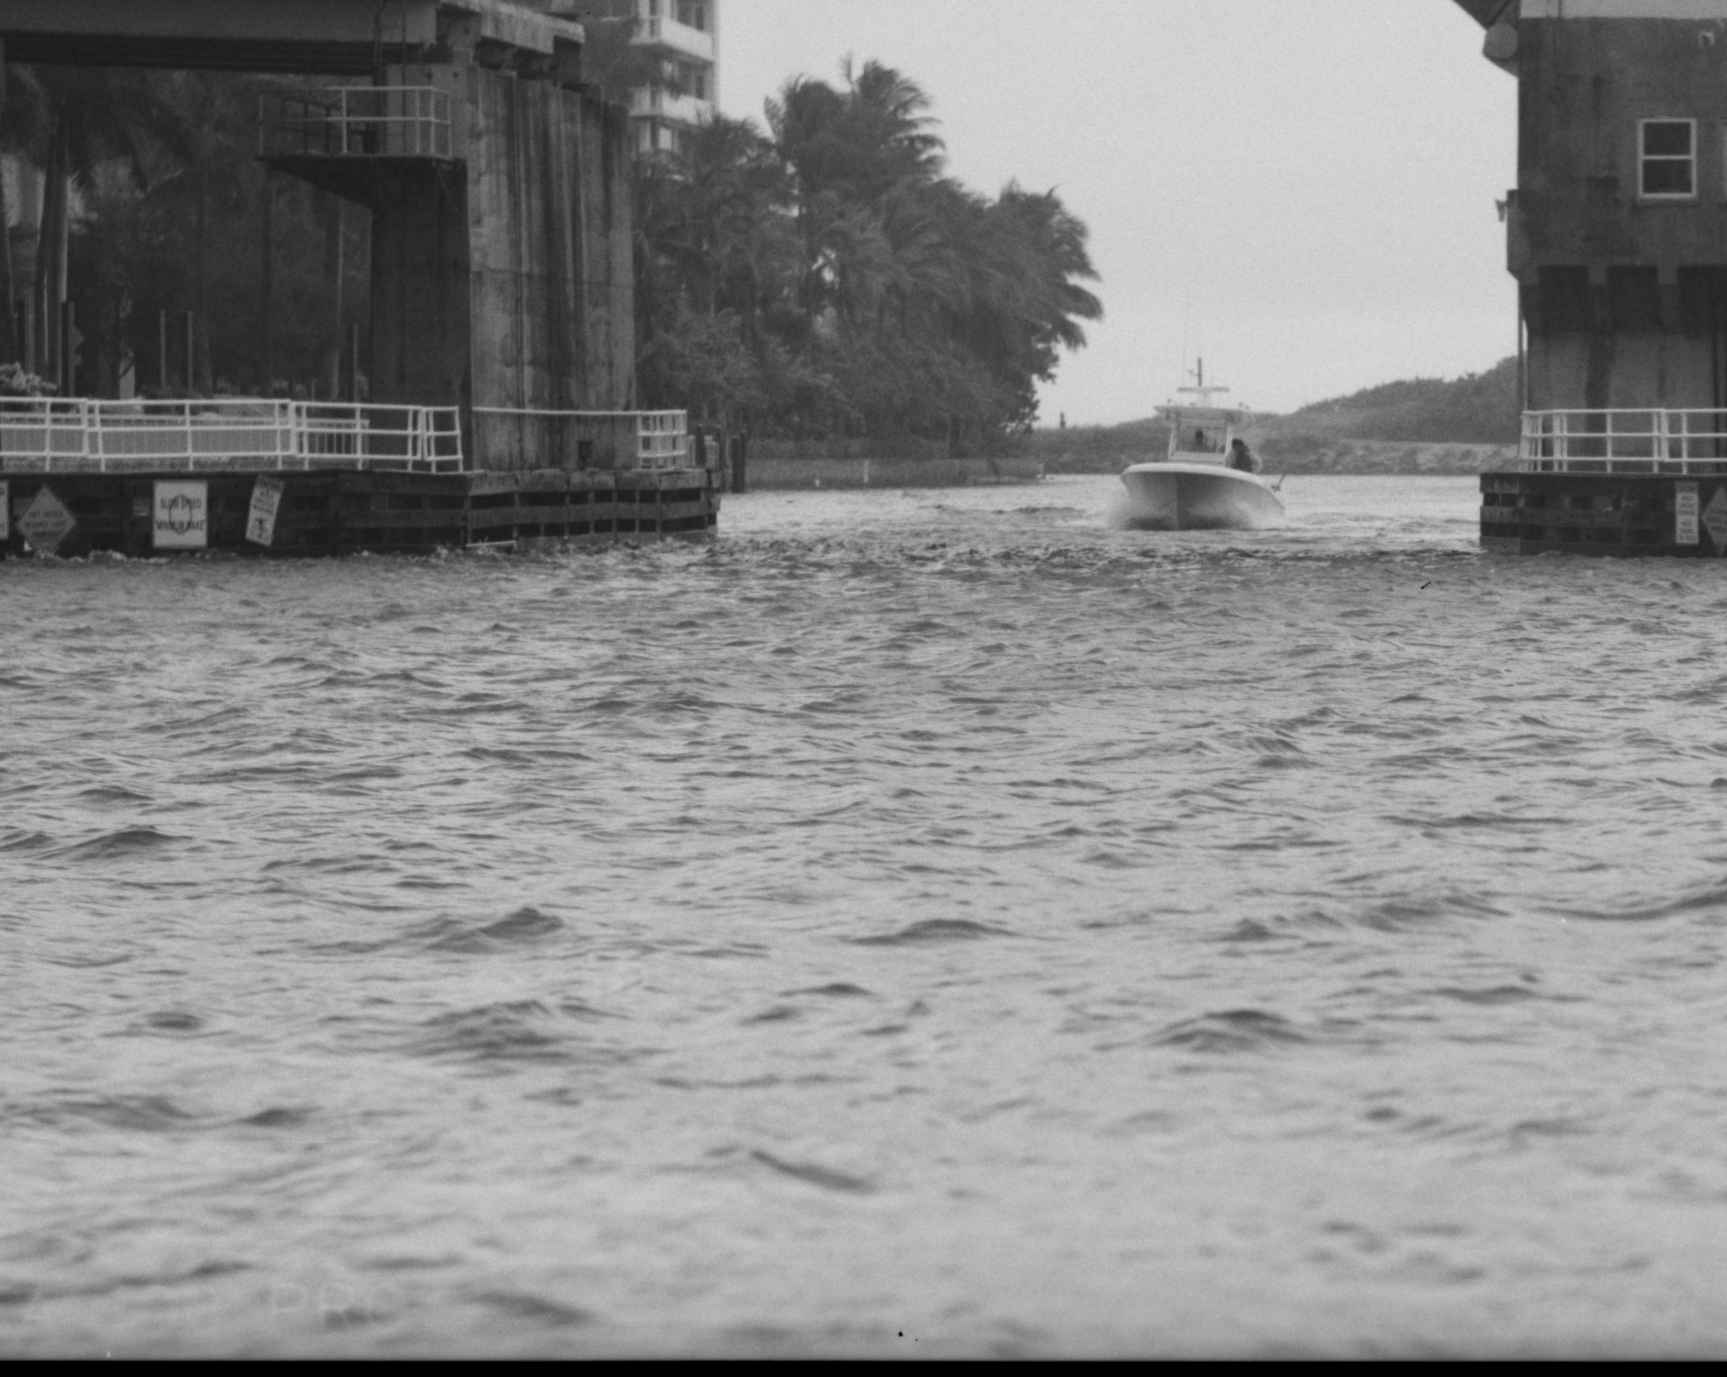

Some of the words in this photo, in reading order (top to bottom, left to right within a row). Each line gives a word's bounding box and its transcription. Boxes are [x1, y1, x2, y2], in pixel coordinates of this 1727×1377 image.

[160, 498, 179, 510] SLOW
[180, 498, 202, 510] SPEED
[155, 520, 185, 531] MINIMUM
[186, 520, 204, 531] WAKE
